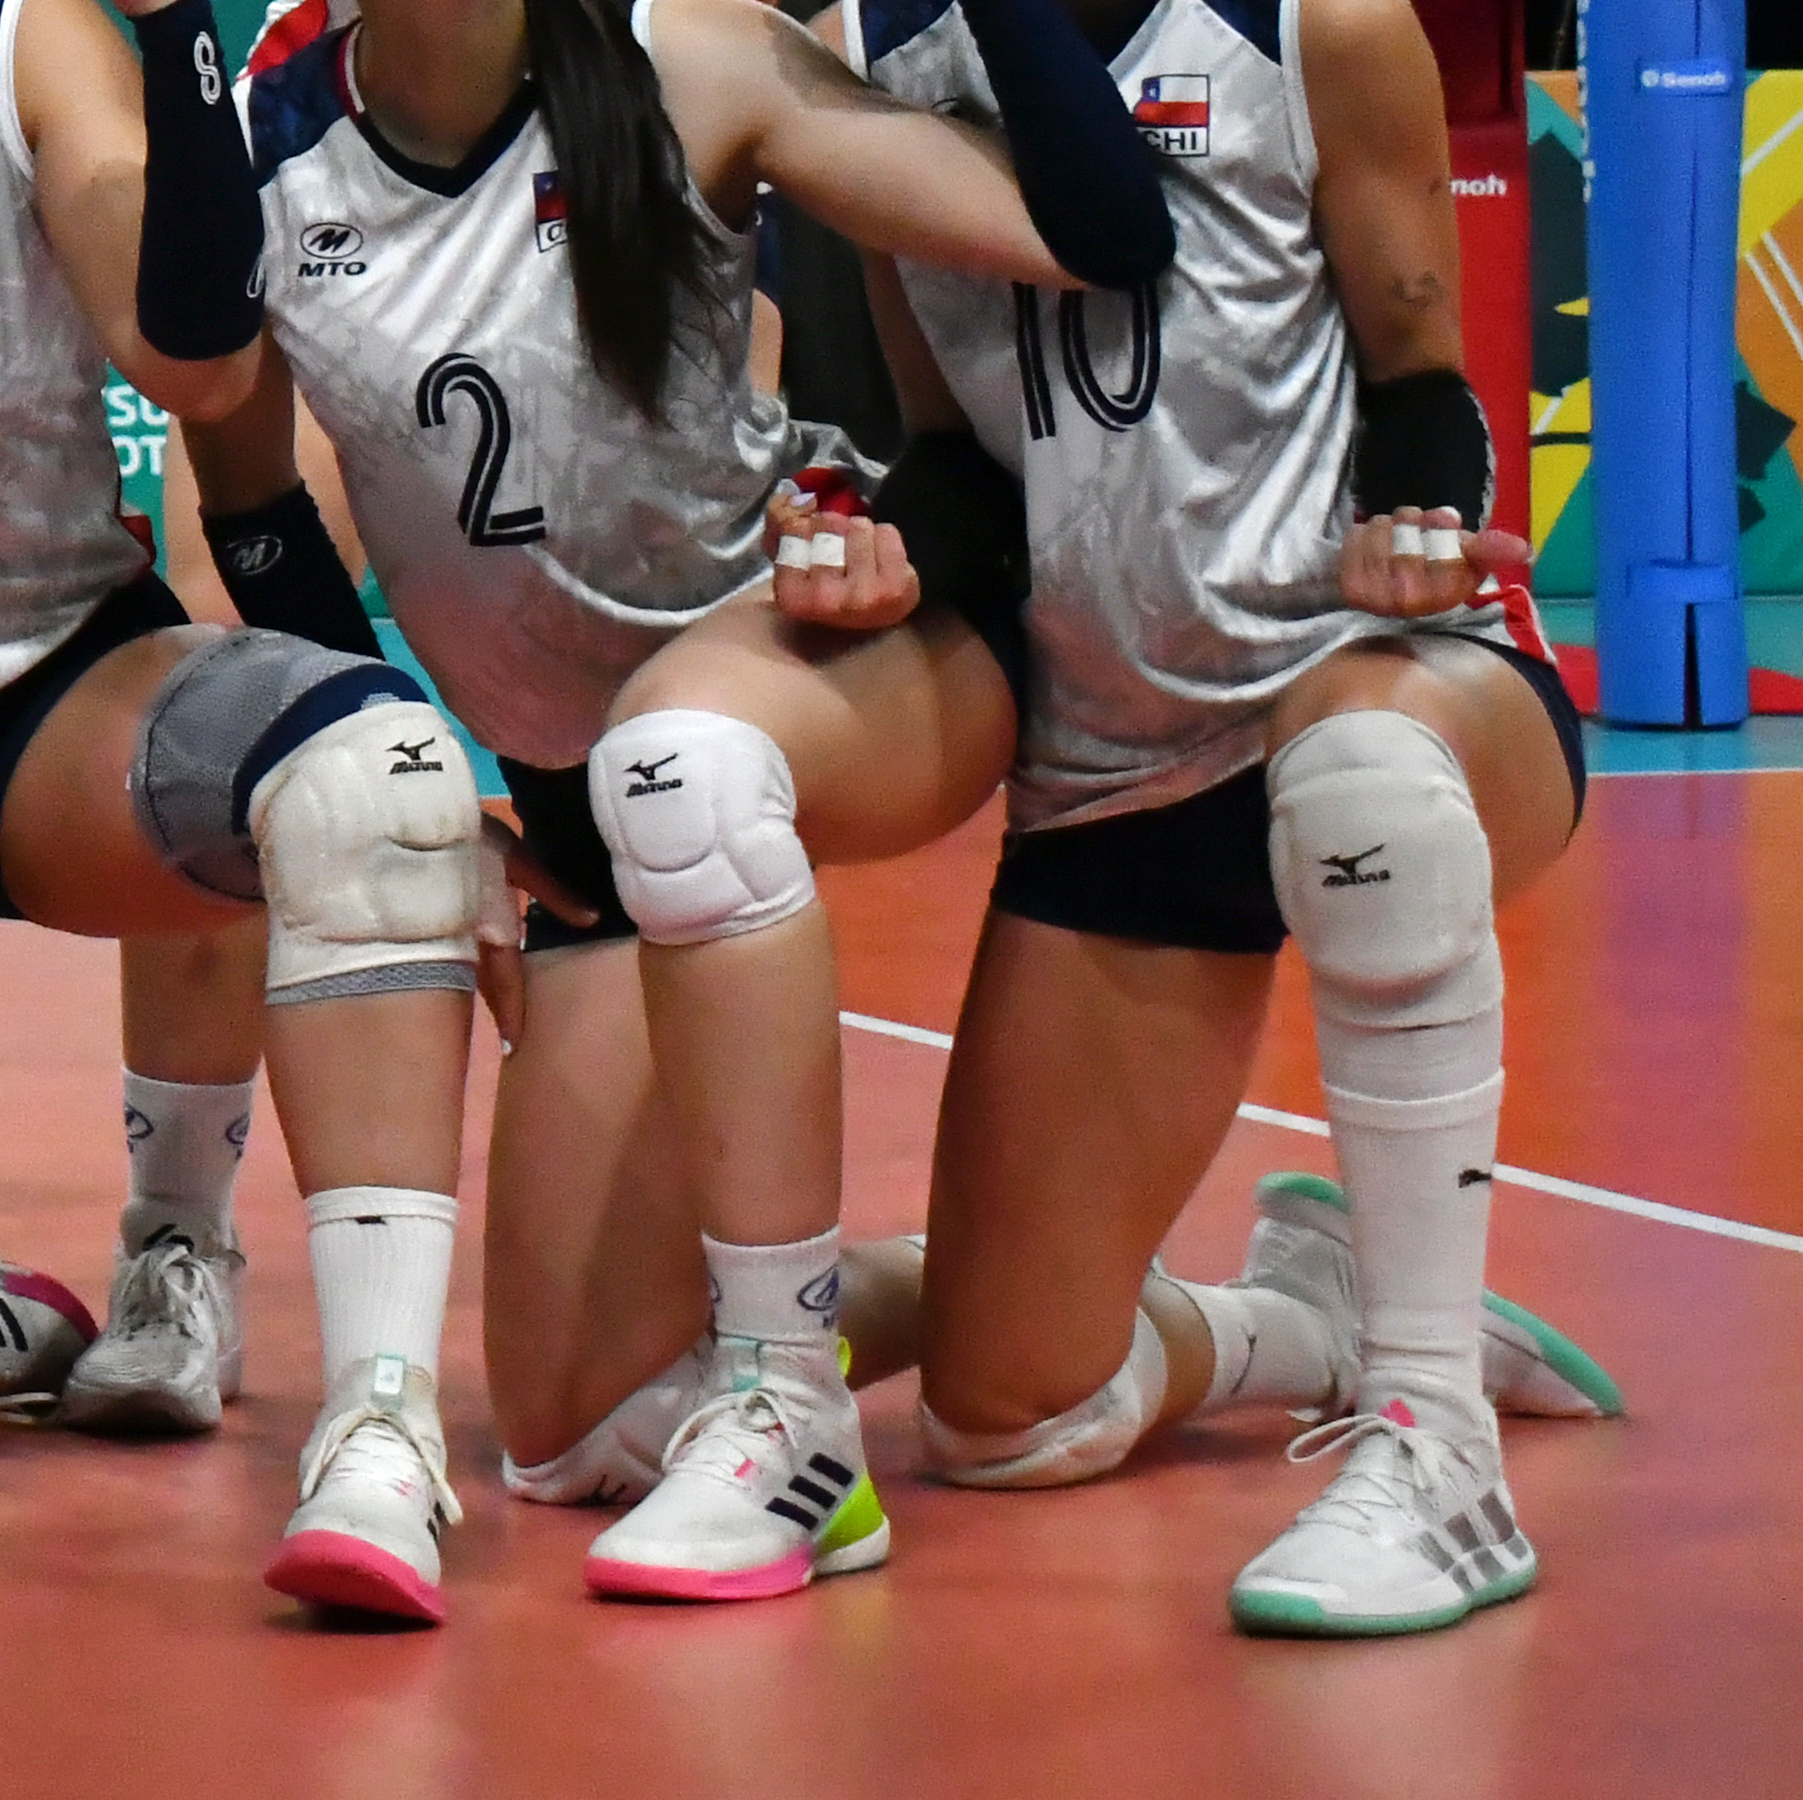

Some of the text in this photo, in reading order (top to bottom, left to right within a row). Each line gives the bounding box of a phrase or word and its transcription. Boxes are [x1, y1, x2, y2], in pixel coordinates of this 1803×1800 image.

[1144, 131, 1197, 151] CHI
[1450, 173, 1507, 196] noh
[298, 261, 366, 278] MTO
[1013, 280, 1161, 440] 10
[416, 352, 546, 546] 2
